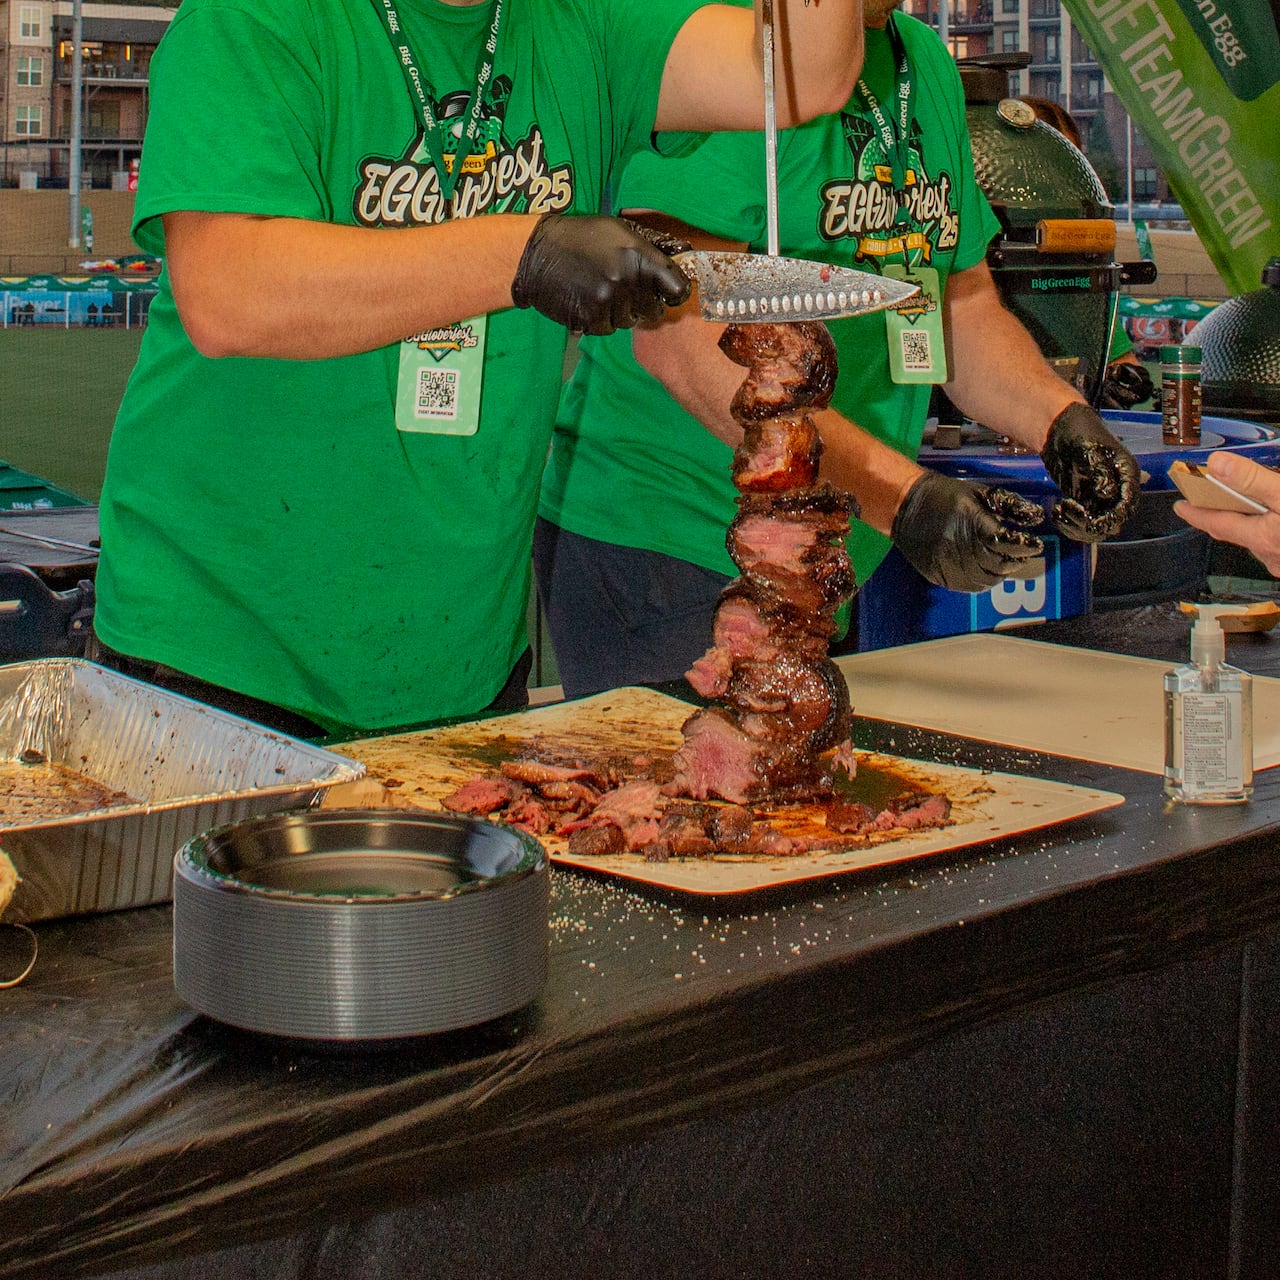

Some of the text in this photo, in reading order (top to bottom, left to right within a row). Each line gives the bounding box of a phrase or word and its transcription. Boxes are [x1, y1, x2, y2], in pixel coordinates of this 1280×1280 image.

[1207, 13, 1248, 68] Egg
[399, 46, 413, 66] Big
[408, 66, 426, 103] Green
[528, 169, 571, 215] 25
[939, 215, 958, 249] 25
[1031, 276, 1091, 290] Big Green Egg
